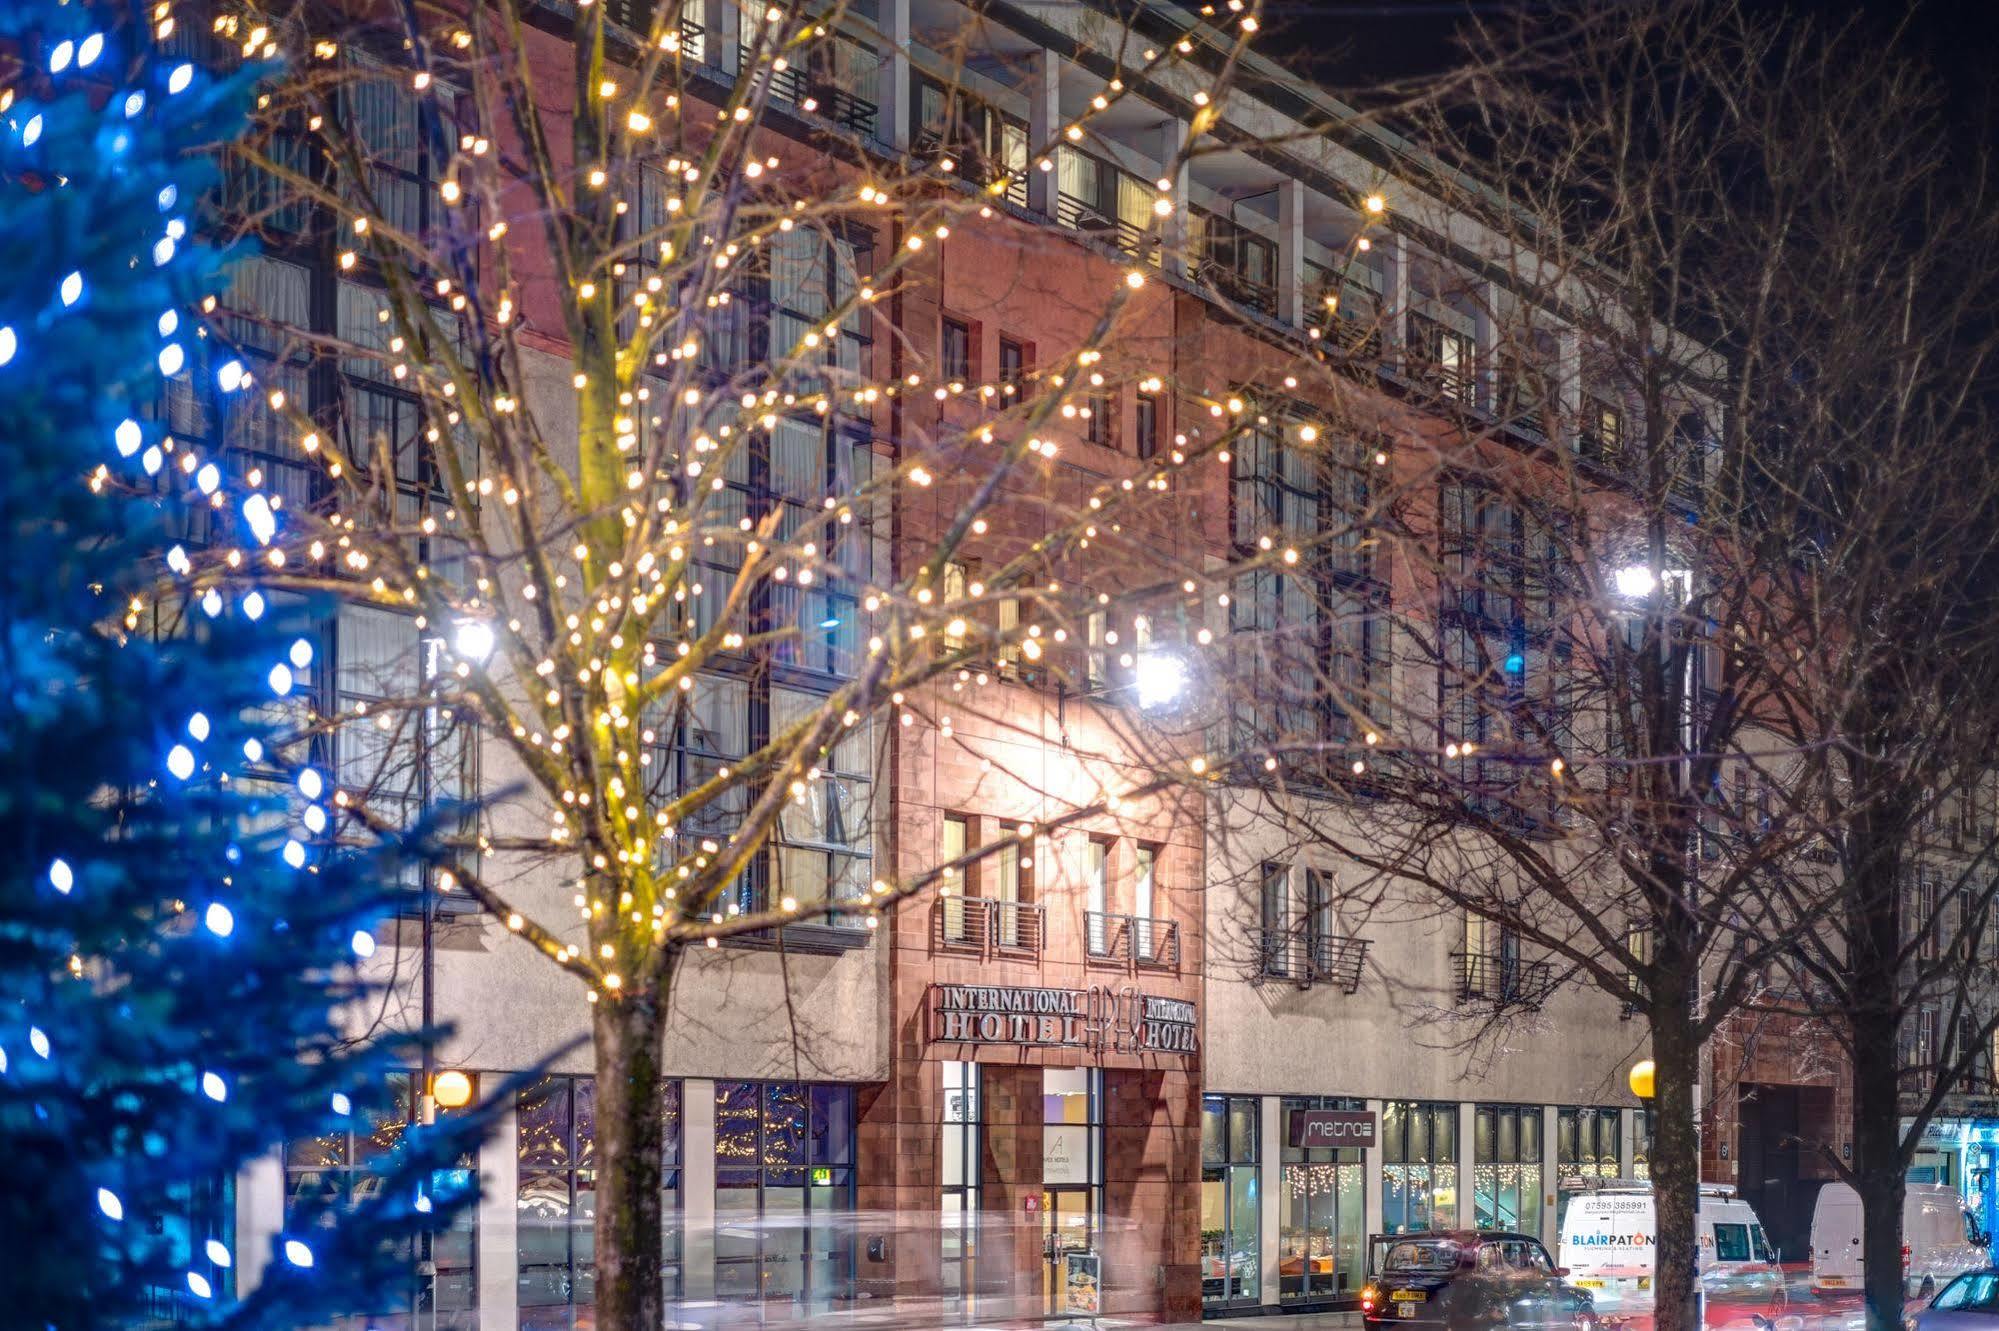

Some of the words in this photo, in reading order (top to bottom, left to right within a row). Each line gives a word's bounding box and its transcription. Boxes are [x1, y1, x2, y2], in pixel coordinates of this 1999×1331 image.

[943, 986, 1080, 1014] INTERNATIONAL
[943, 1012, 1080, 1043] HOTEL
[1145, 1022, 1197, 1052] HOTEL
[1585, 1201, 1612, 1210] 07595
[1614, 1201, 1647, 1210] 385991
